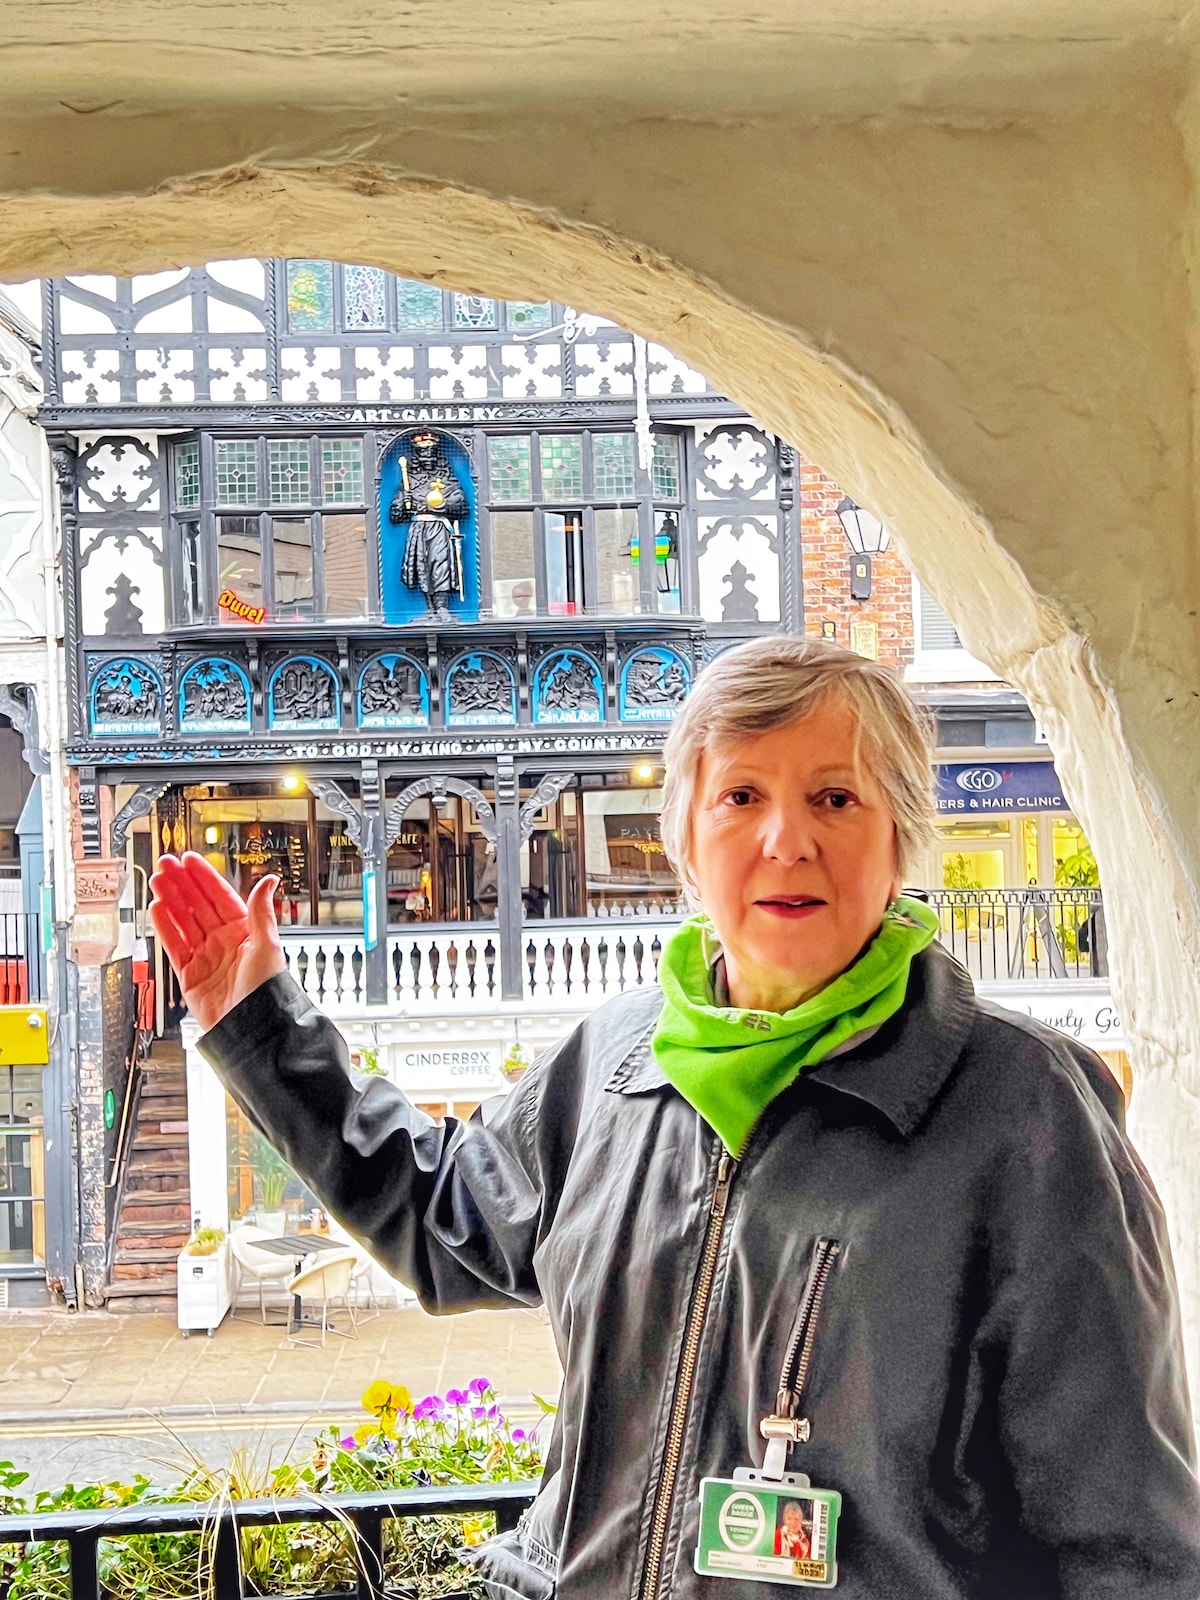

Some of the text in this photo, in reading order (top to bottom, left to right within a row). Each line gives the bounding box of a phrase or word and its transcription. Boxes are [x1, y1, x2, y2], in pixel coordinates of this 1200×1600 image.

[350, 407, 499, 422] ART GALLERY
[218, 588, 265, 624] Duvel
[292, 738, 646, 759] TO GOD MY KING AND MY COUNTRY
[962, 770, 995, 789] EGO
[969, 798, 979, 808] &
[982, 797, 1014, 808] HAIR
[1017, 796, 1061, 807] CLINIC
[405, 1051, 490, 1066] CINDERBOX
[451, 1065, 491, 1076] COFFEE
